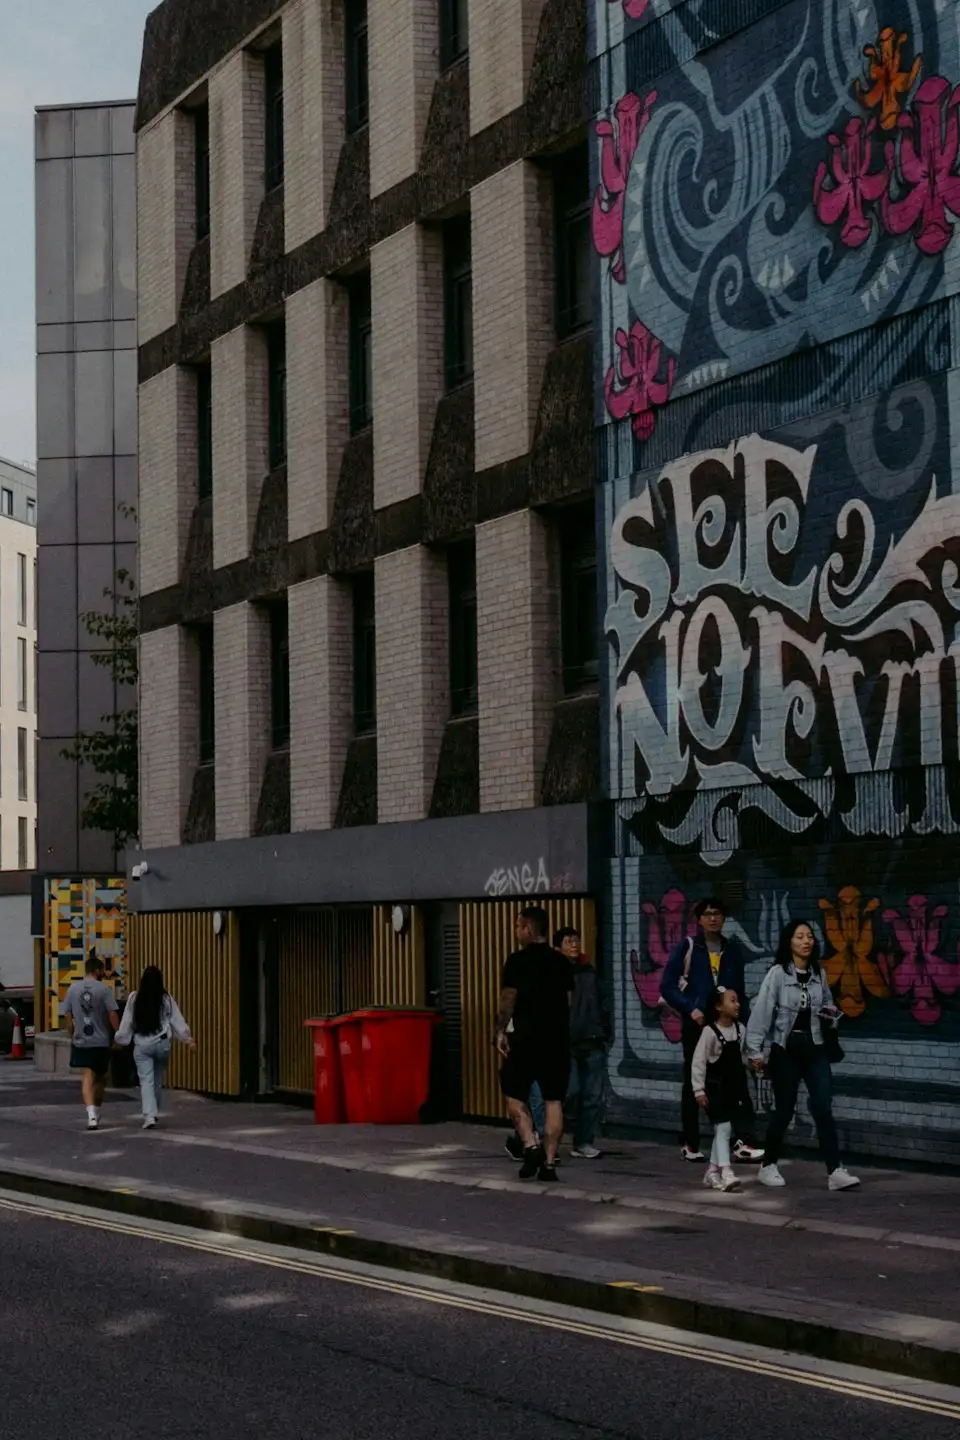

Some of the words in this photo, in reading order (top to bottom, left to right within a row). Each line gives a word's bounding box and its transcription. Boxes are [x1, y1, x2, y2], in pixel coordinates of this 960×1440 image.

[604, 433, 819, 676] SEE
[613, 595, 750, 819] NO
[749, 604, 960, 836] EVI
